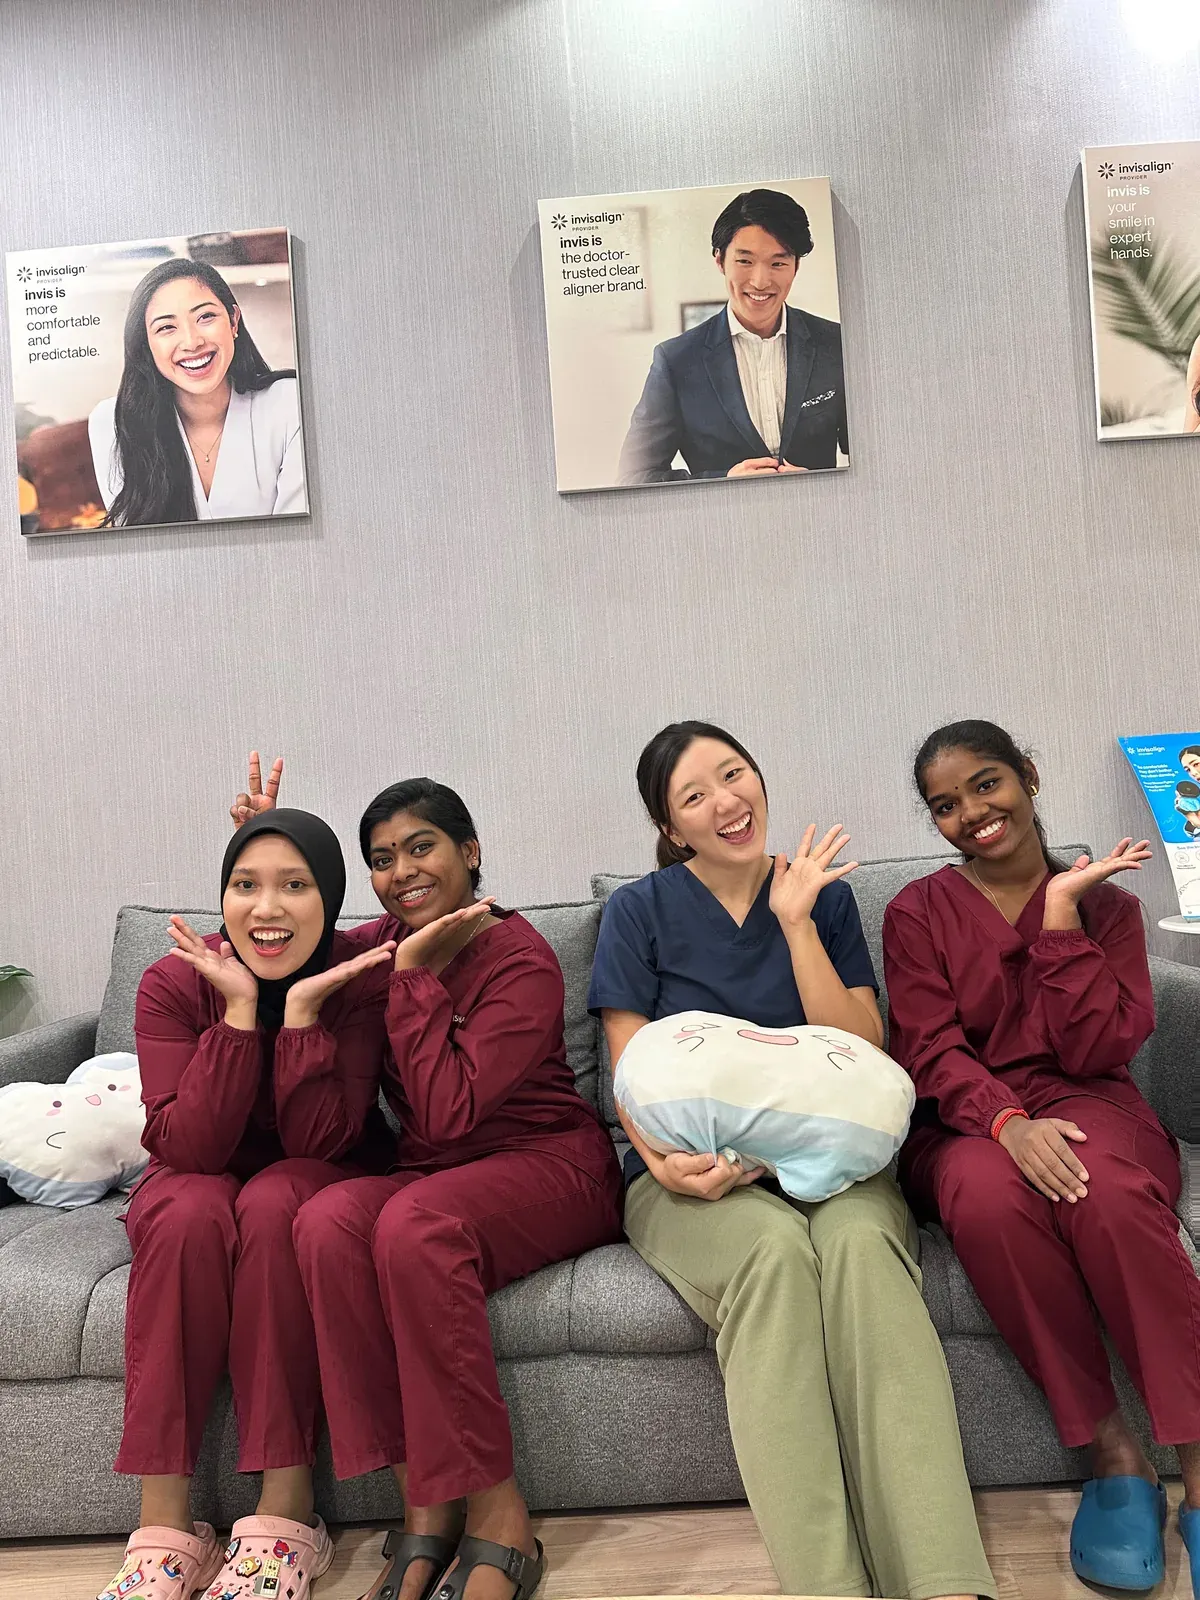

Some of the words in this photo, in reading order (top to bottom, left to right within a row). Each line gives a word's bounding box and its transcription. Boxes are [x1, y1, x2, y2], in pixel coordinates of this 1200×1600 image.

[1119, 161, 1171, 173] invisalign
[1107, 185, 1137, 198] invis
[1139, 184, 1151, 196] is
[1107, 202, 1137, 216] your
[571, 212, 622, 225] invisalign
[1108, 216, 1142, 229] smile
[1144, 215, 1155, 226] in
[560, 235, 589, 249] invis
[591, 234, 603, 246] is
[1109, 230, 1152, 245] expert
[561, 252, 582, 264] the
[583, 249, 630, 263] doctor-
[1110, 246, 1153, 260] hands.
[36, 265, 85, 277] invisalign
[562, 265, 607, 280] trusted
[609, 264, 640, 276] clear
[25, 288, 54, 301] invis
[55, 287, 66, 298] is
[563, 283, 605, 297] aligner
[607, 278, 647, 292] brand.
[26, 305, 58, 316] more
[26, 315, 101, 331] comfortable
[28, 334, 51, 346] and
[28, 346, 100, 364] predictable.
